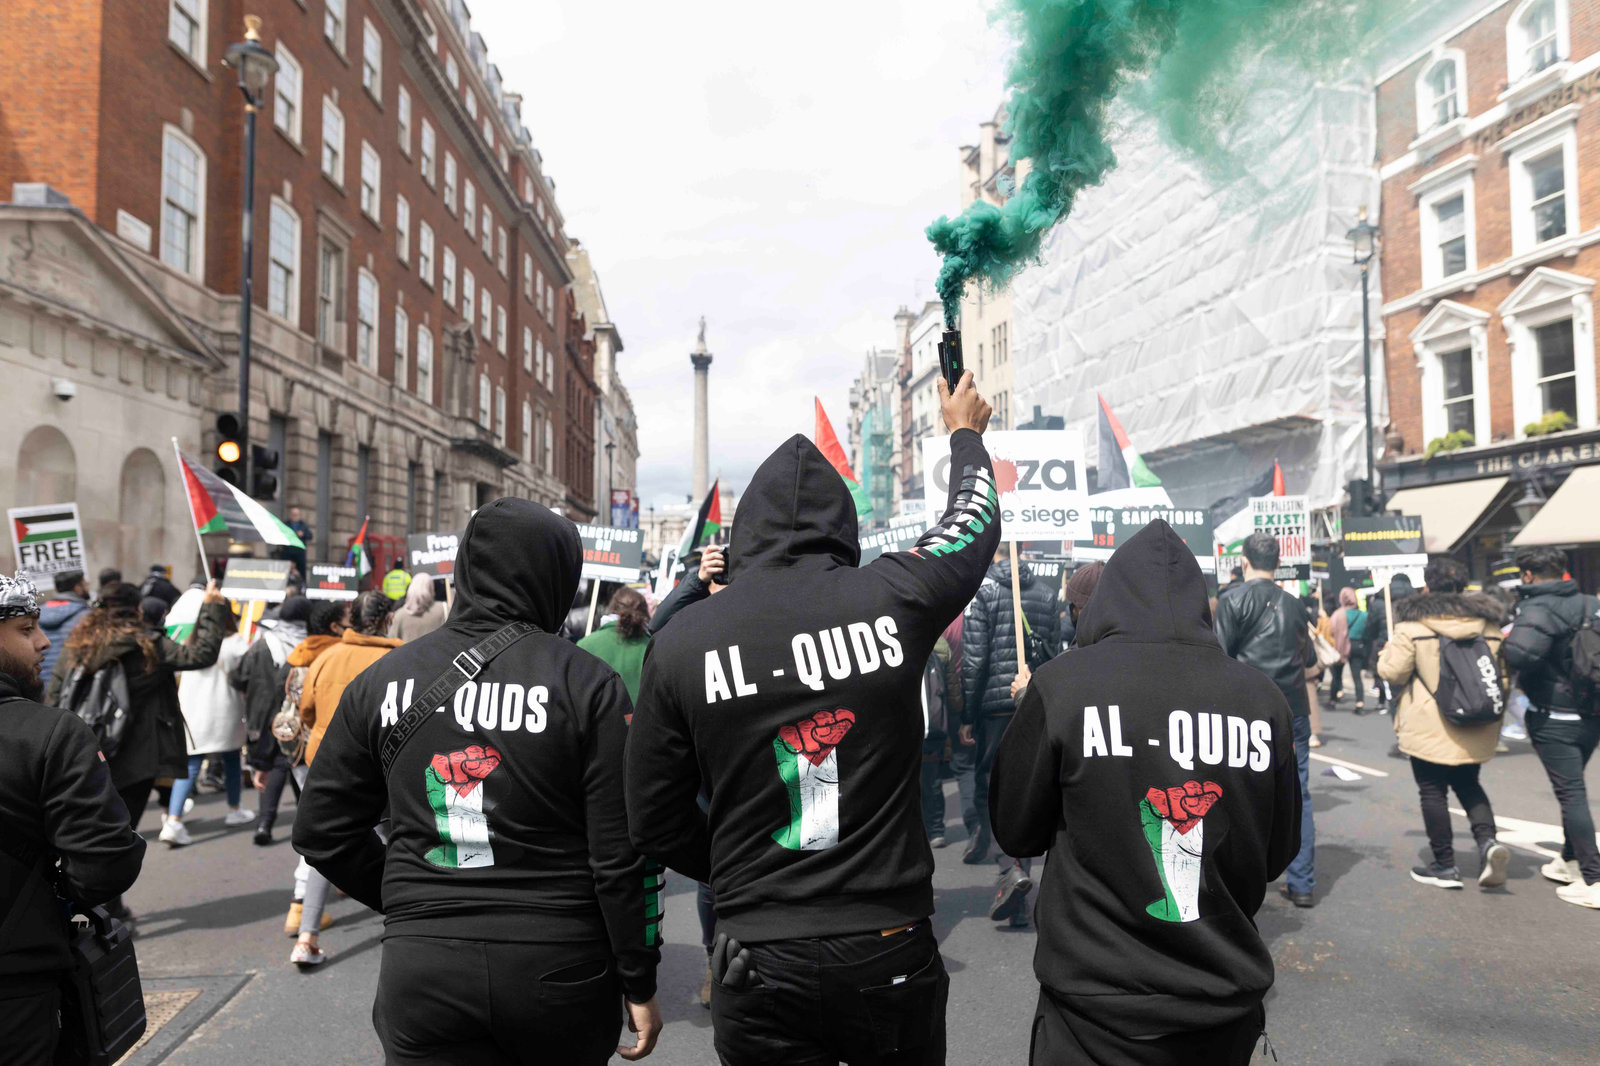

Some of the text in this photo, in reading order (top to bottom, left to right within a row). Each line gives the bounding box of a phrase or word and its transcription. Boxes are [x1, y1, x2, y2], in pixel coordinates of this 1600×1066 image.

[1475, 457, 1513, 474] THE
[1021, 505, 1079, 527] siege
[1122, 510, 1204, 525] SANCTIONS
[1254, 514, 1305, 526] EXIST!
[19, 540, 81, 564] FREE
[595, 539, 612, 552] ON
[882, 543, 899, 553] ON
[583, 548, 621, 565] ISRAEL
[705, 645, 758, 704] AL
[791, 615, 904, 691] QUDS
[453, 680, 549, 733] QUDS
[1083, 705, 1133, 757] AL
[1168, 710, 1272, 772] QUDS
